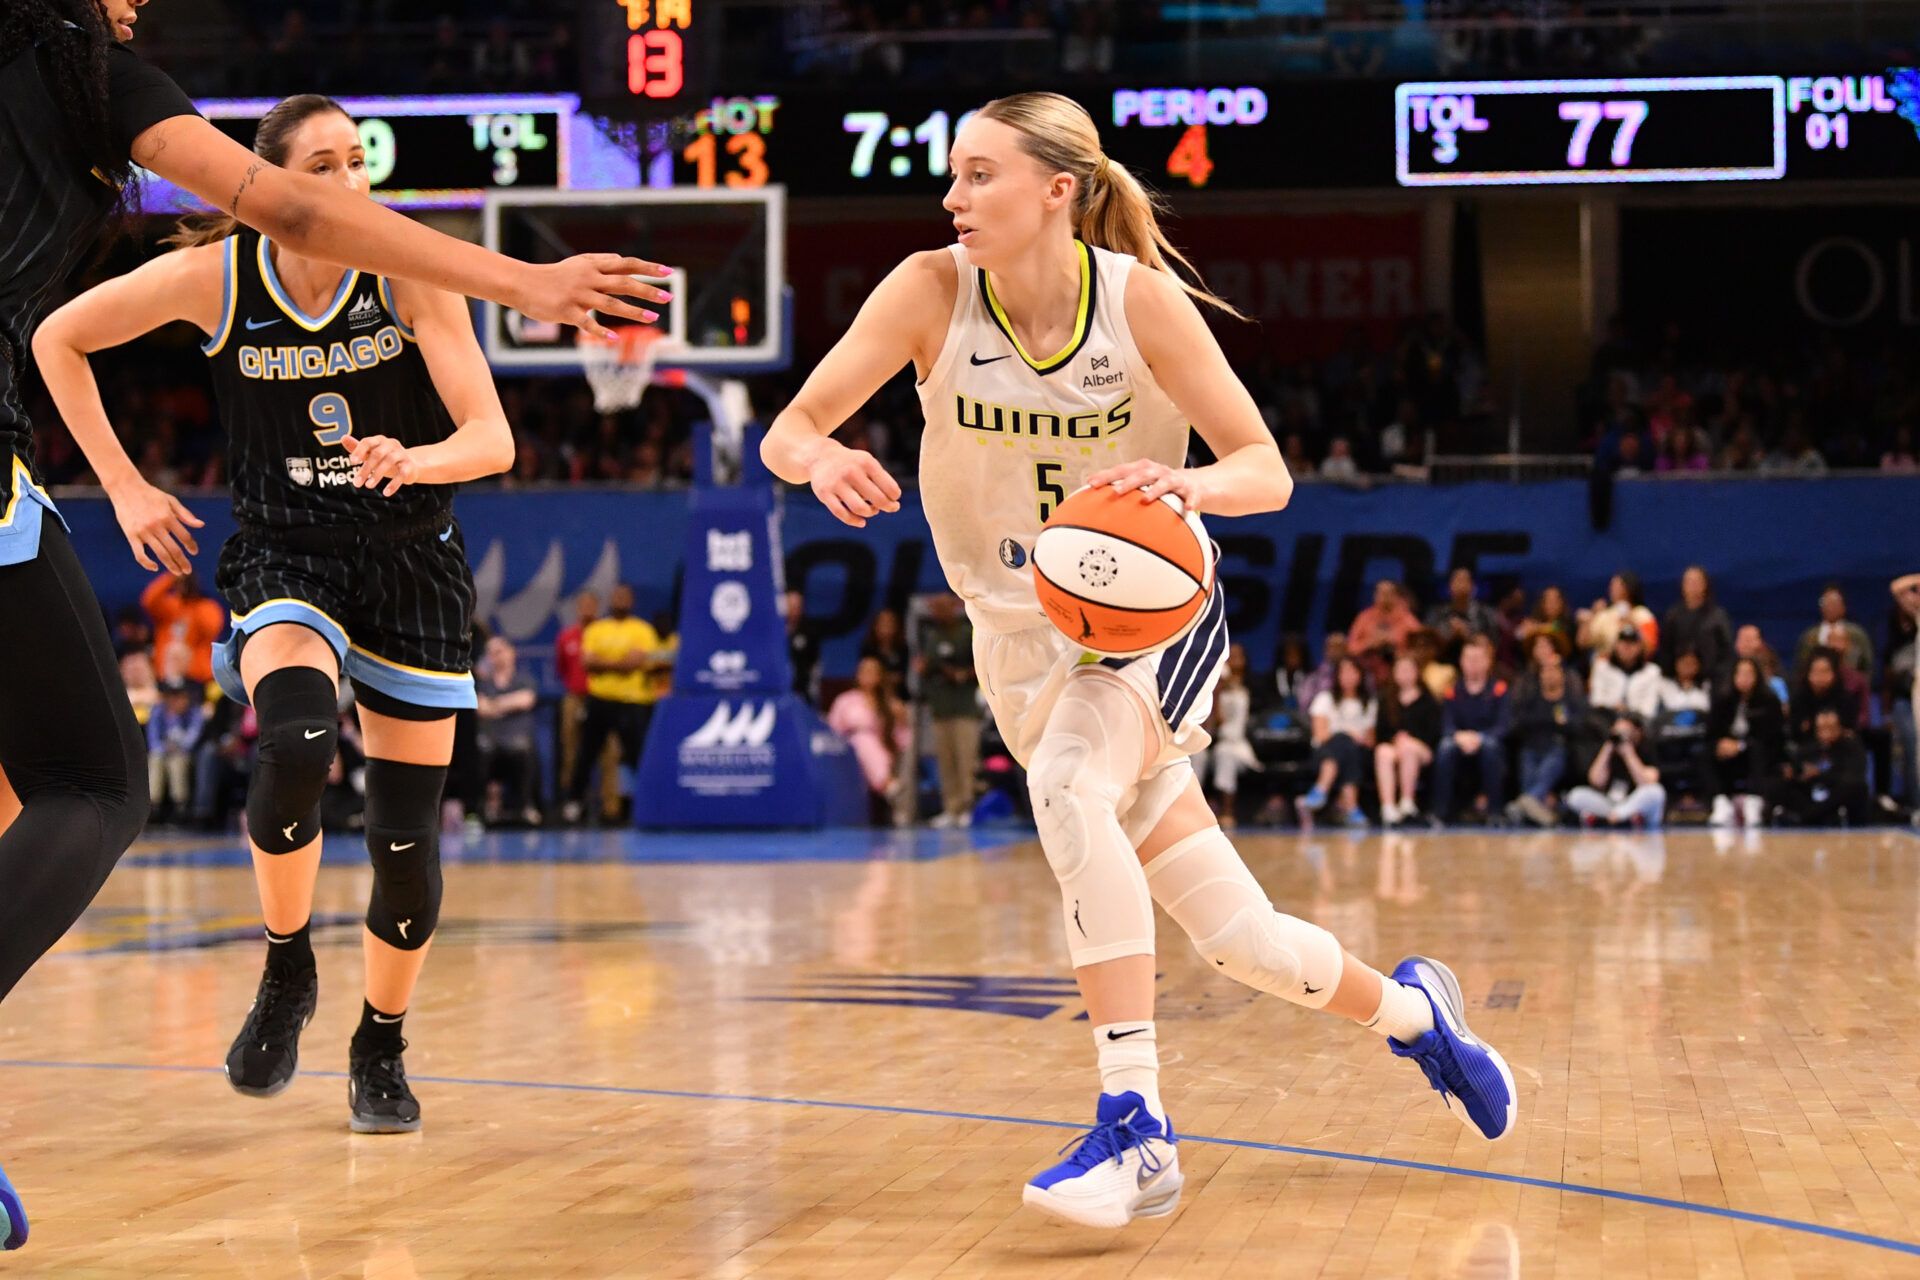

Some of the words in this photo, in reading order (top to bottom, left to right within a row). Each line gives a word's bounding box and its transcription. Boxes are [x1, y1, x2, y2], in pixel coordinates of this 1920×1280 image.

[628, 30, 683, 98] 13
[671, 95, 781, 135] HOT
[1112, 87, 1268, 127] PERIOD
[1409, 95, 1489, 132] TOL
[1787, 76, 1896, 113] FOUL
[467, 114, 548, 150] TOL
[842, 110, 979, 178] 7:1
[1432, 131, 1459, 165] 3
[1558, 101, 1649, 167] 77
[1806, 112, 1849, 150] 01
[492, 149, 519, 186] 3
[683, 131, 770, 190] 13
[1166, 125, 1214, 187] 4
[238, 325, 403, 380] CHICAGO
[1082, 371, 1124, 389] Albert
[308, 392, 353, 446] 9
[955, 391, 1134, 440] WINGS
[1035, 461, 1066, 524] 5
